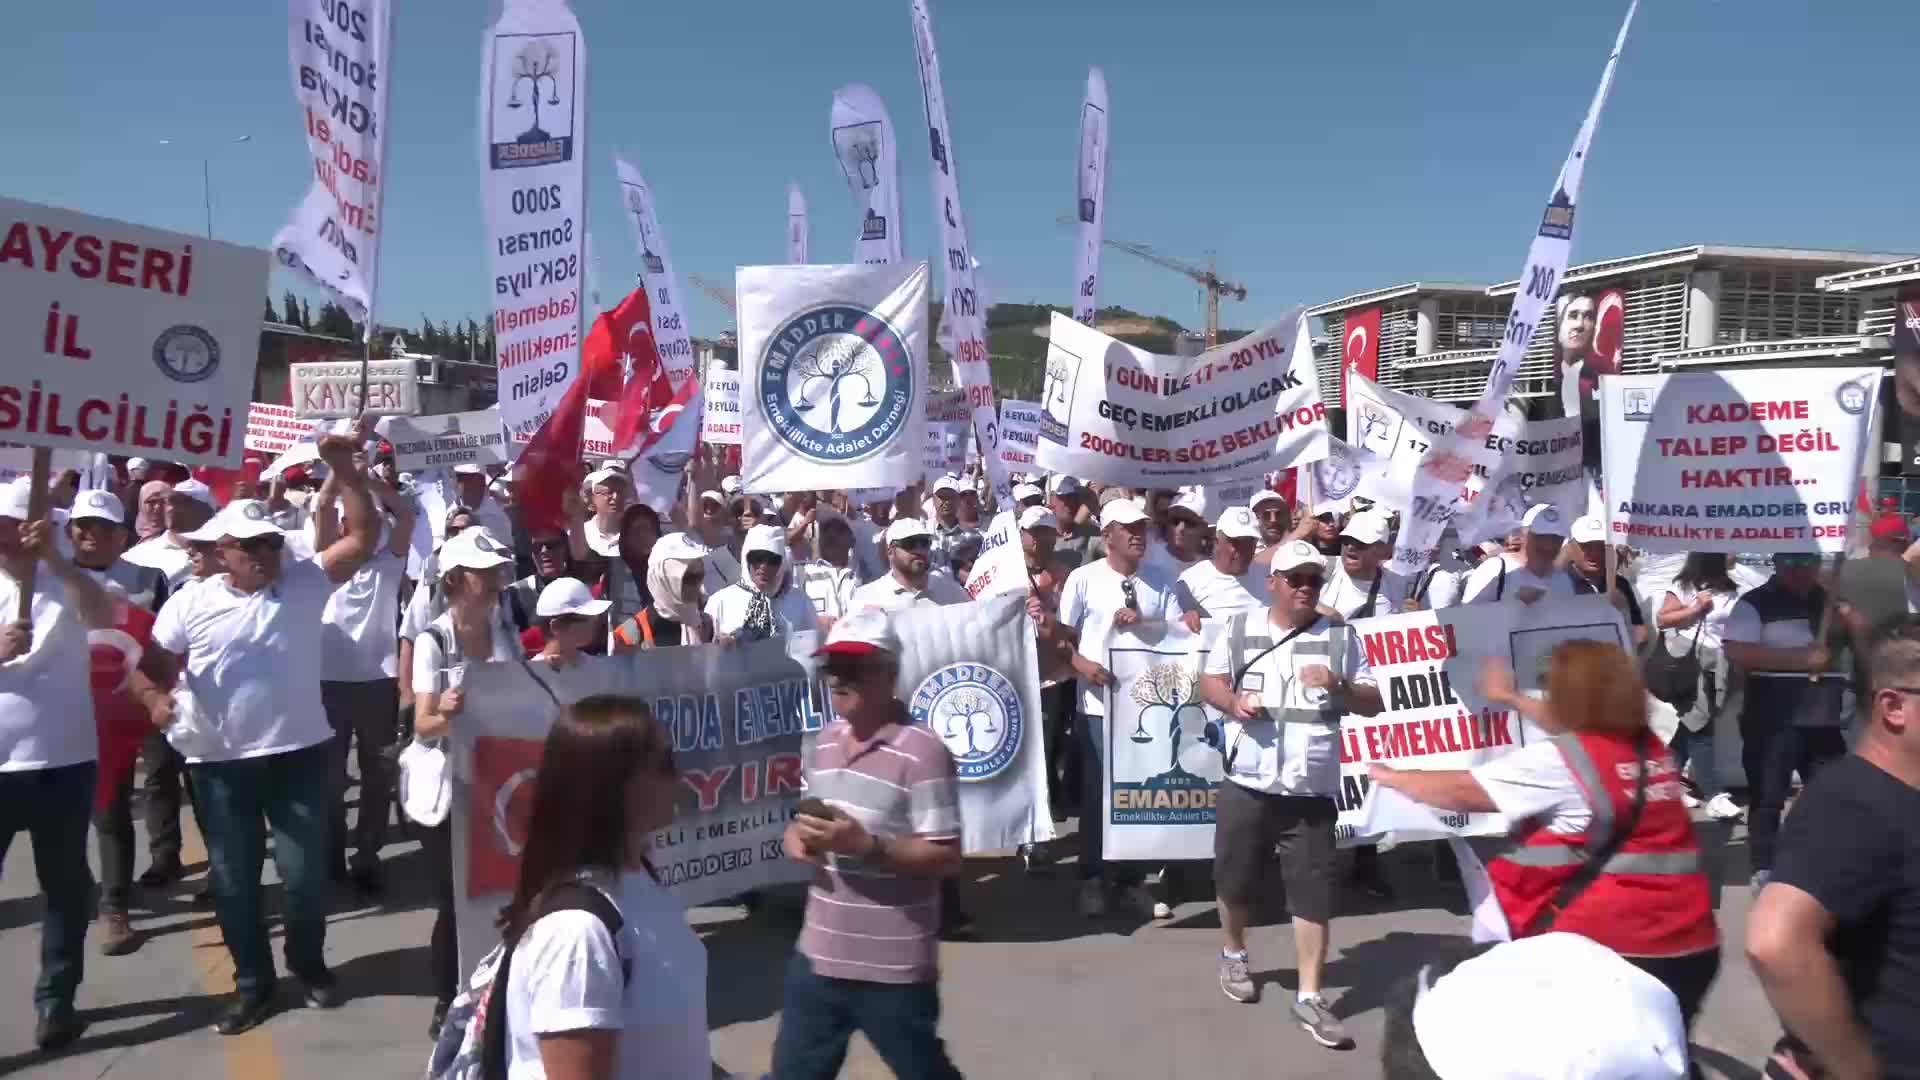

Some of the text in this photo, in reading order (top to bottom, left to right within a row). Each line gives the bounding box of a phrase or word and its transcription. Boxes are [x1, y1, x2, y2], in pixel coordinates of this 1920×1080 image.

[43, 300, 92, 361] İL
[766, 312, 846, 382] EMADDER
[1116, 364, 1159, 395] GÜN
[1164, 368, 1192, 396] İLE
[1251, 336, 1286, 362] YIL
[1098, 368, 1304, 432] GEÇ EMEKLİ OLACAK
[1687, 401, 1809, 424] KADEME
[708, 423, 741, 434] ADALET
[825, 434, 874, 455] Adalet
[1656, 427, 1840, 456] TALEP DEĞİL
[1175, 438, 1220, 464] SÖZ
[1618, 501, 1699, 518] ANKARA
[1706, 502, 1807, 517] EMADDER
[1611, 520, 1725, 540] EMEKLİLİKTE
[1730, 525, 1806, 540] ADALET
[1364, 624, 1457, 667] NRASI
[1390, 666, 1458, 711] ADİL
[1364, 707, 1513, 760] EMEKLİLİK
